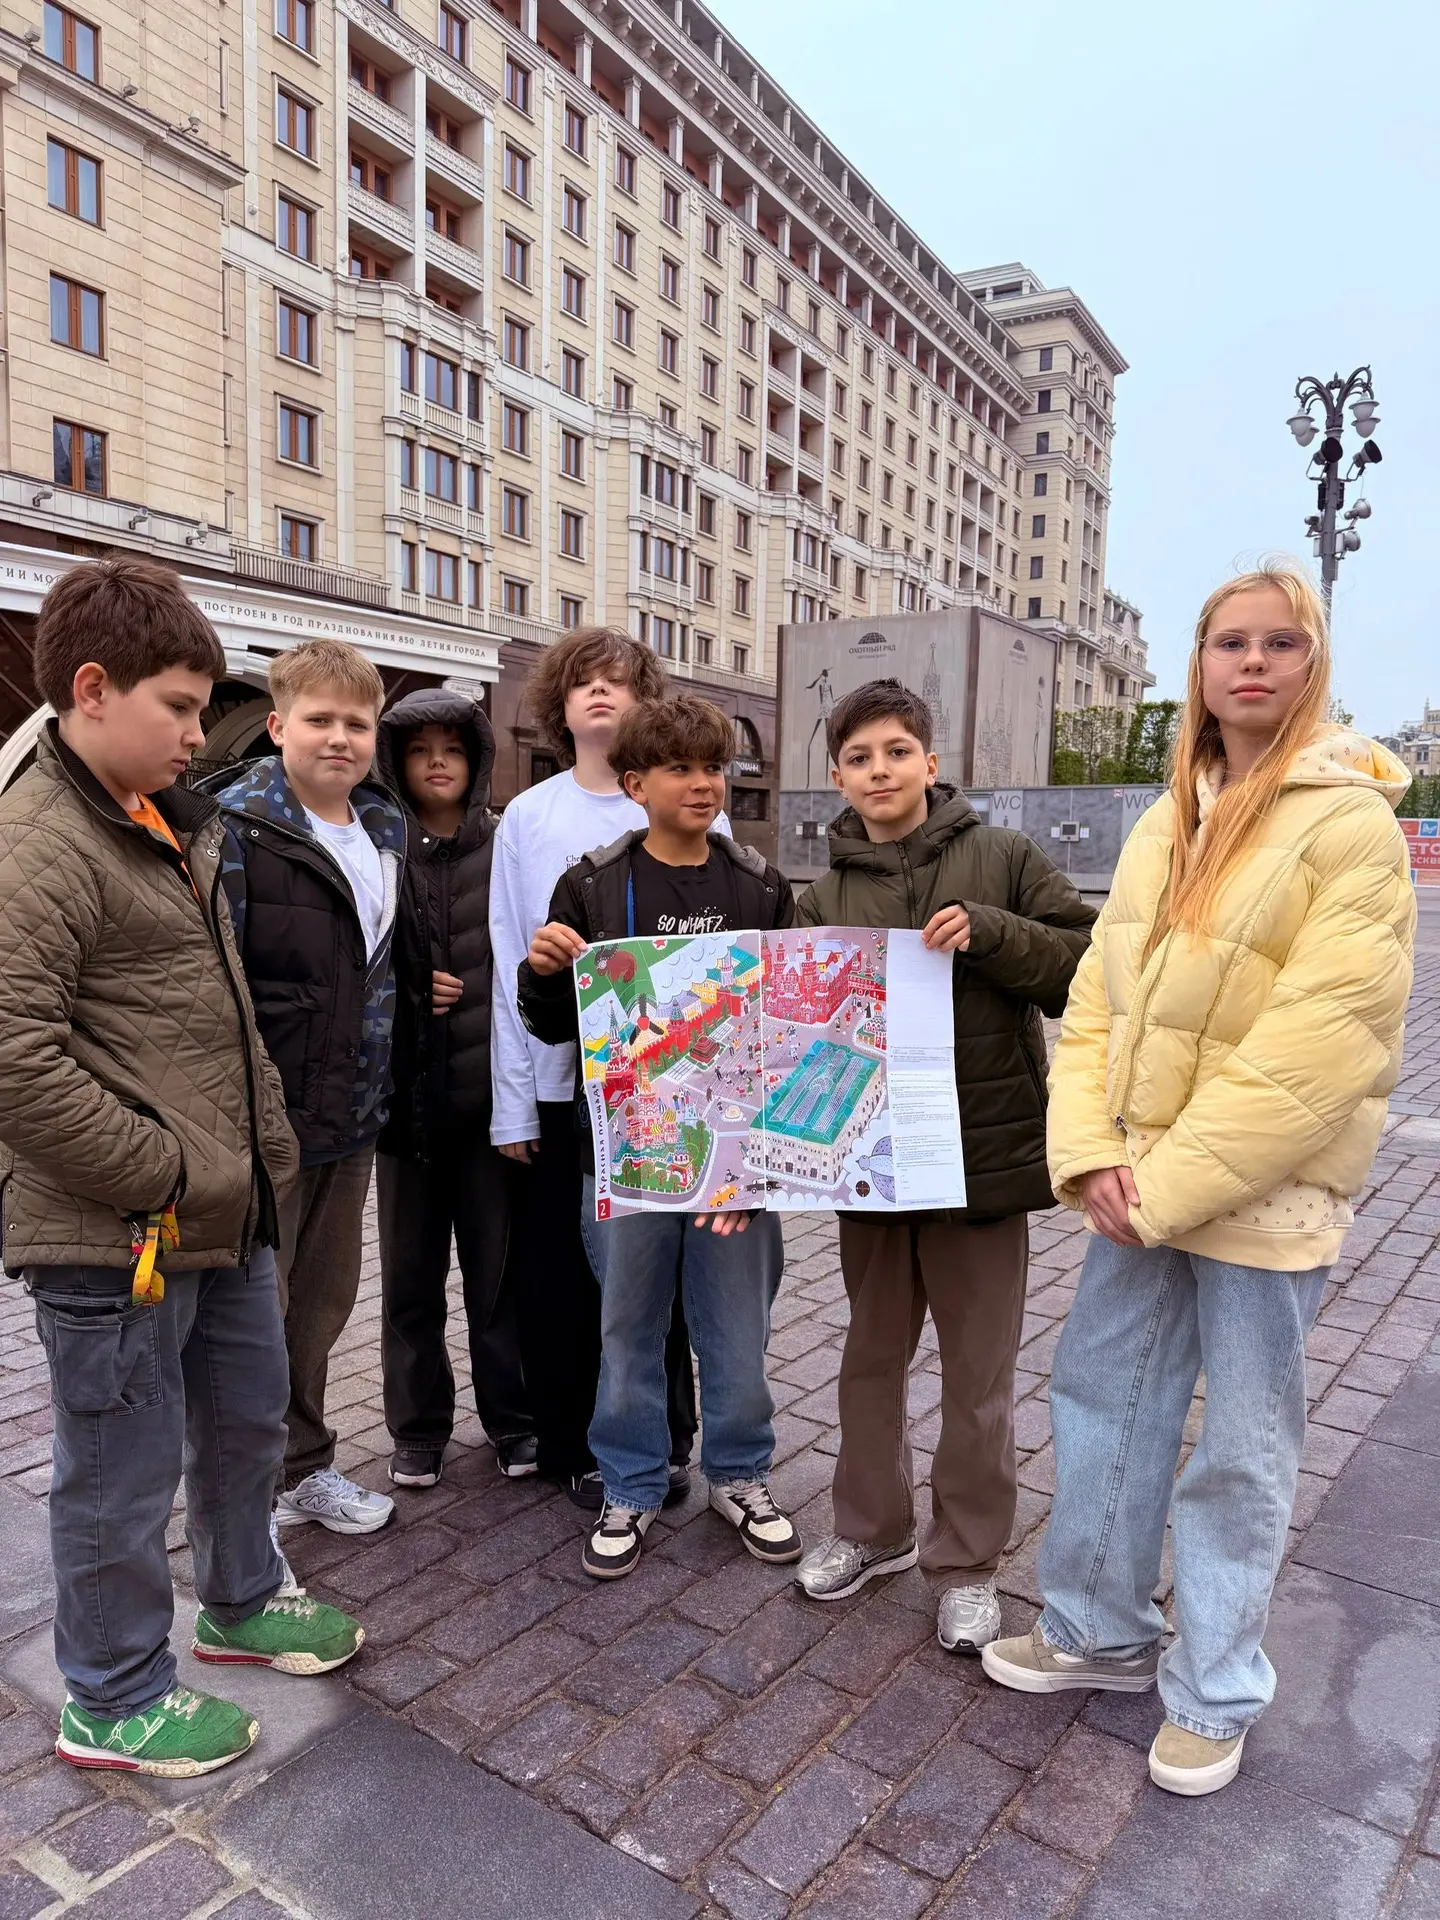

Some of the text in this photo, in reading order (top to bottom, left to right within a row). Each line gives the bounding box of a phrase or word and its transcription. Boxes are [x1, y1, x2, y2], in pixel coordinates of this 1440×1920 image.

[0, 566, 26, 580] ИИ
[204, 601, 486, 658] ПОСТРОЕН В ГОД ПРАЗДНОВАНИЯ 850 ЛЕТИЯ ГОРОДА
[993, 794, 1021, 810] WC
[1125, 793, 1157, 810] WC
[1408, 842, 1440, 856] ЕТО
[657, 914, 724, 935] SO WHAT?
[600, 1202, 607, 1217] 2
